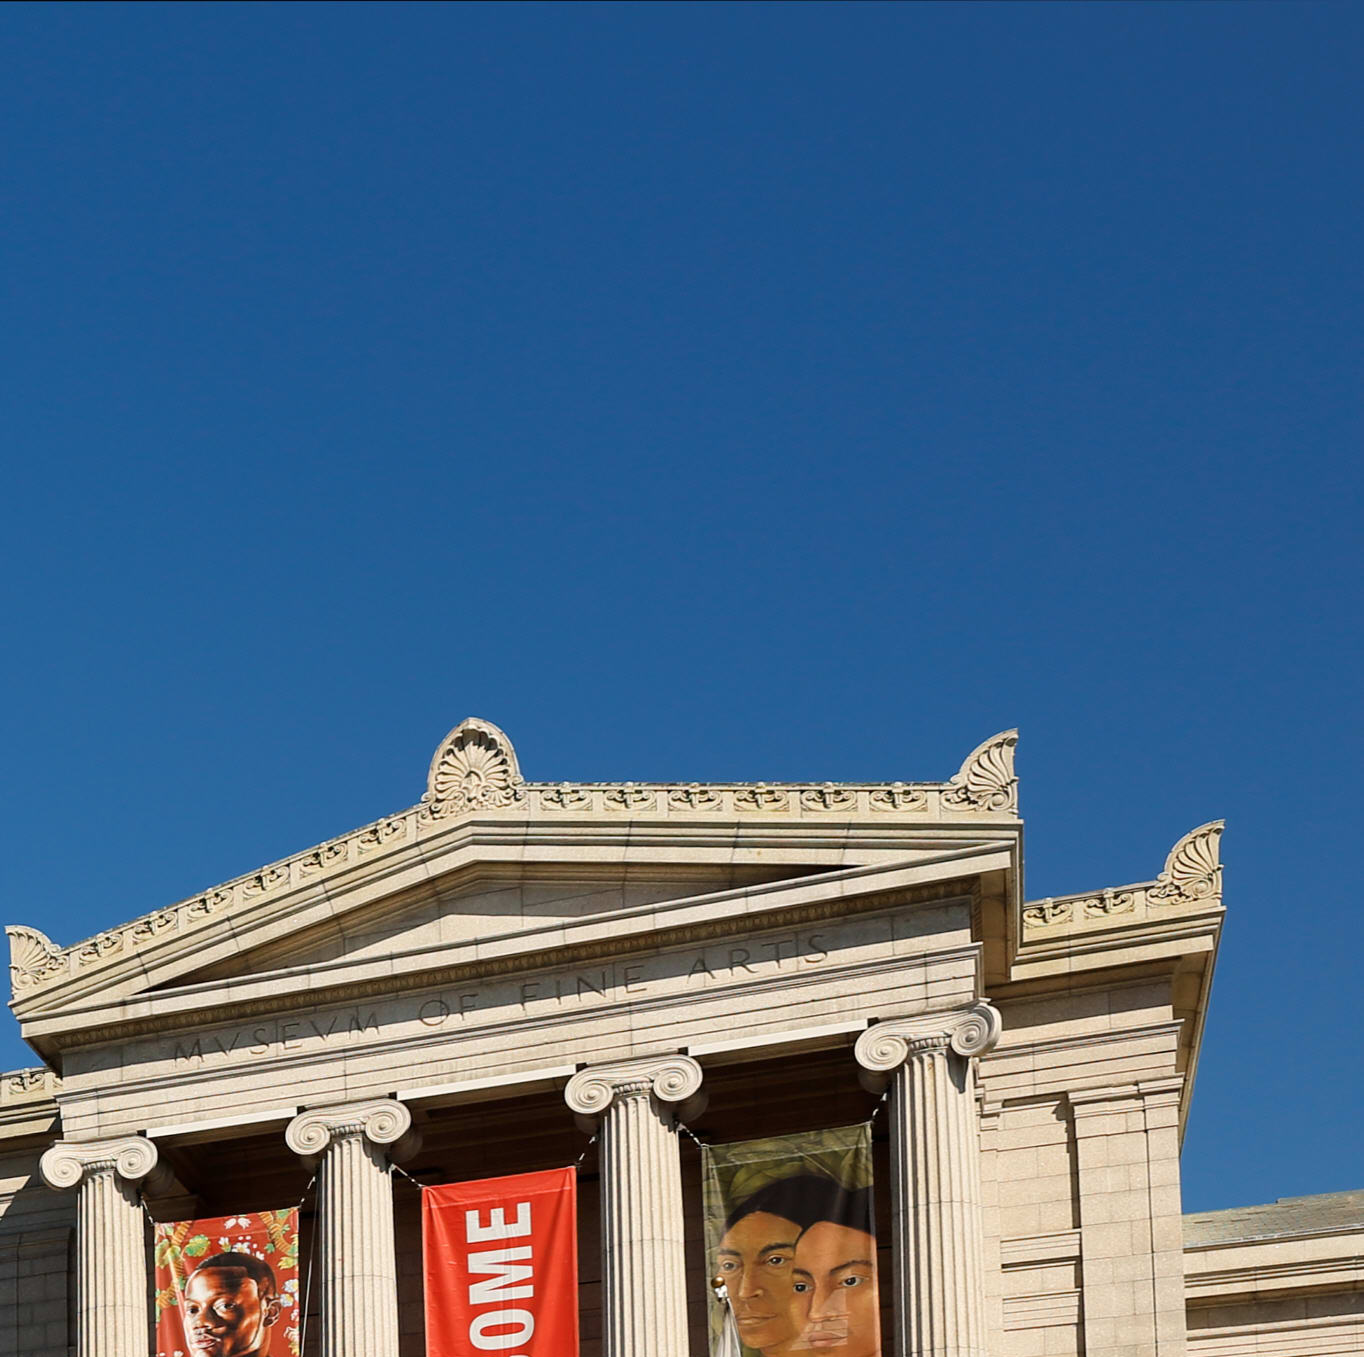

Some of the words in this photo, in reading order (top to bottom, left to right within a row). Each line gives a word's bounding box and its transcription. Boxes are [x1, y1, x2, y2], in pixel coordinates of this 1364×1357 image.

[174, 1013, 380, 1065] MVSEVM
[418, 993, 480, 1027] OF
[520, 964, 648, 1011] FINE
[687, 933, 829, 985] ARTS
